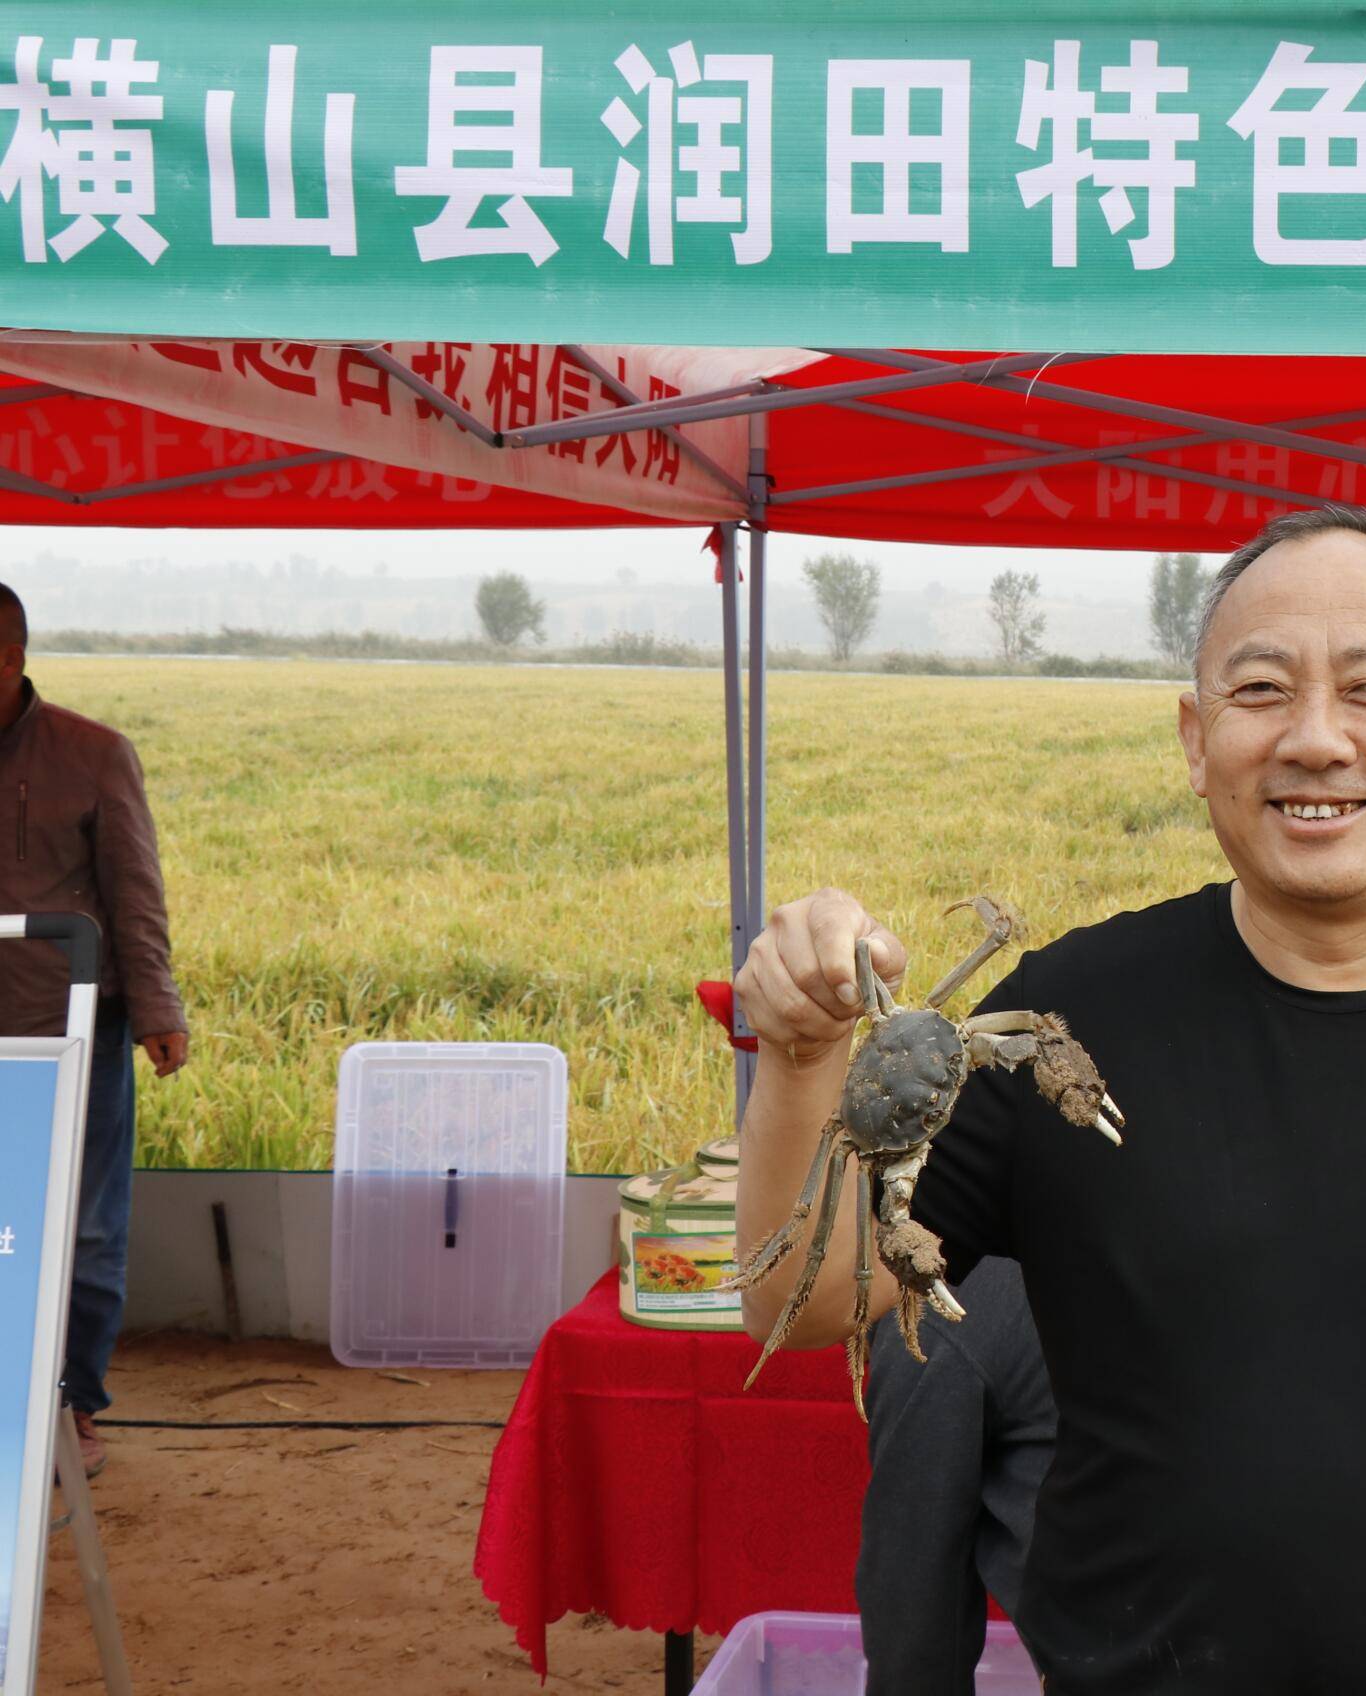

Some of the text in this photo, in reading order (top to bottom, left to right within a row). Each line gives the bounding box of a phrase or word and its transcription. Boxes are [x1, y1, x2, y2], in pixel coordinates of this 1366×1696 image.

[131, 342, 683, 486] 自我相信大阳
